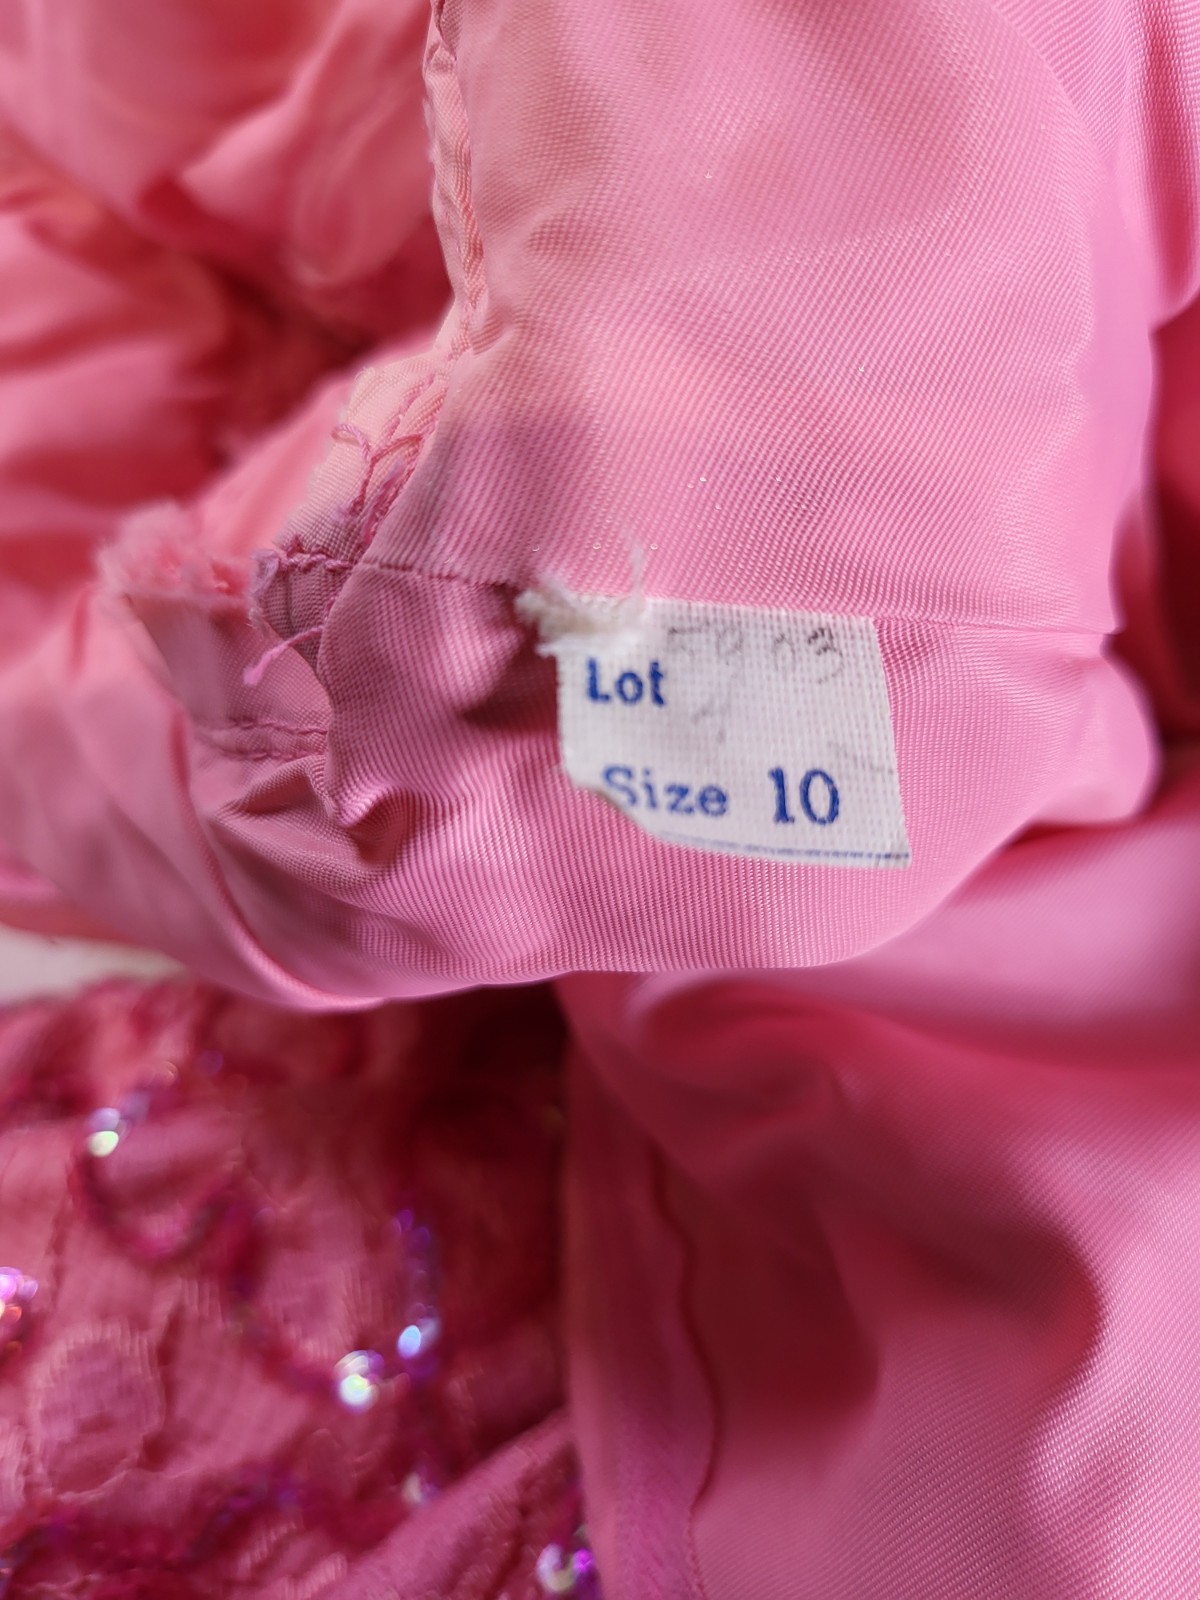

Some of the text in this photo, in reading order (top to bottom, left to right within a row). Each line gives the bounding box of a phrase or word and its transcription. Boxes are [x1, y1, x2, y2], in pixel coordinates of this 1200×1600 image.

[586, 656, 666, 707] Lot
[602, 764, 840, 826] Size 10
